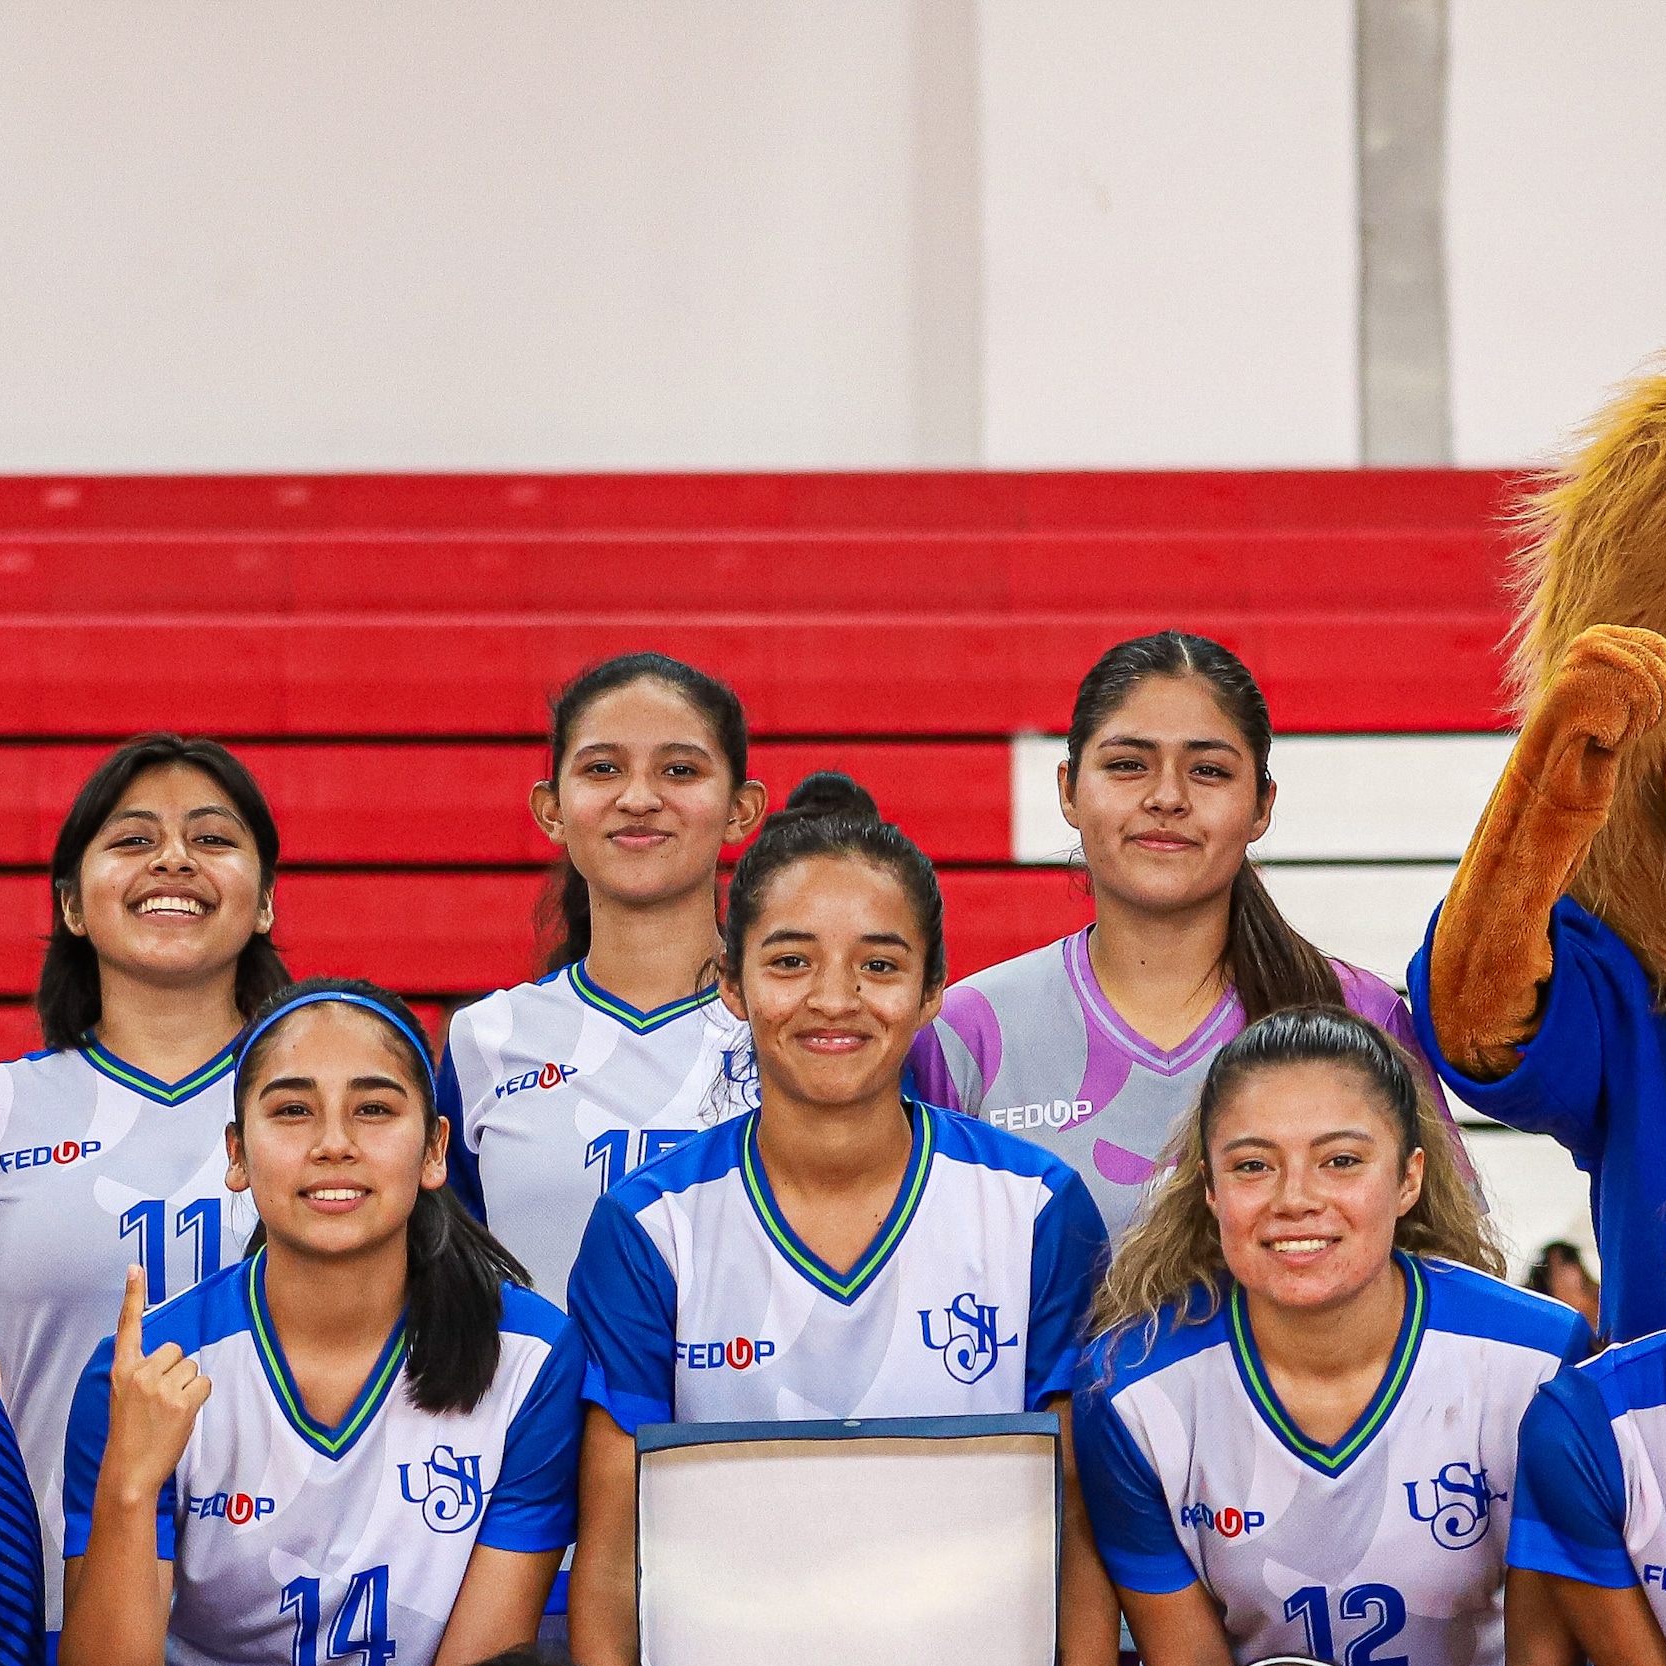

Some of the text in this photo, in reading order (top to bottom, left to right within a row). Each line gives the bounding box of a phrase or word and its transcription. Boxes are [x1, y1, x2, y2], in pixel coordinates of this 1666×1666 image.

[495, 1063, 578, 1099] FEDUP
[989, 1099, 1094, 1133] FEDUP
[0, 1140, 102, 1174] FEDUP
[120, 1198, 222, 1305] 11
